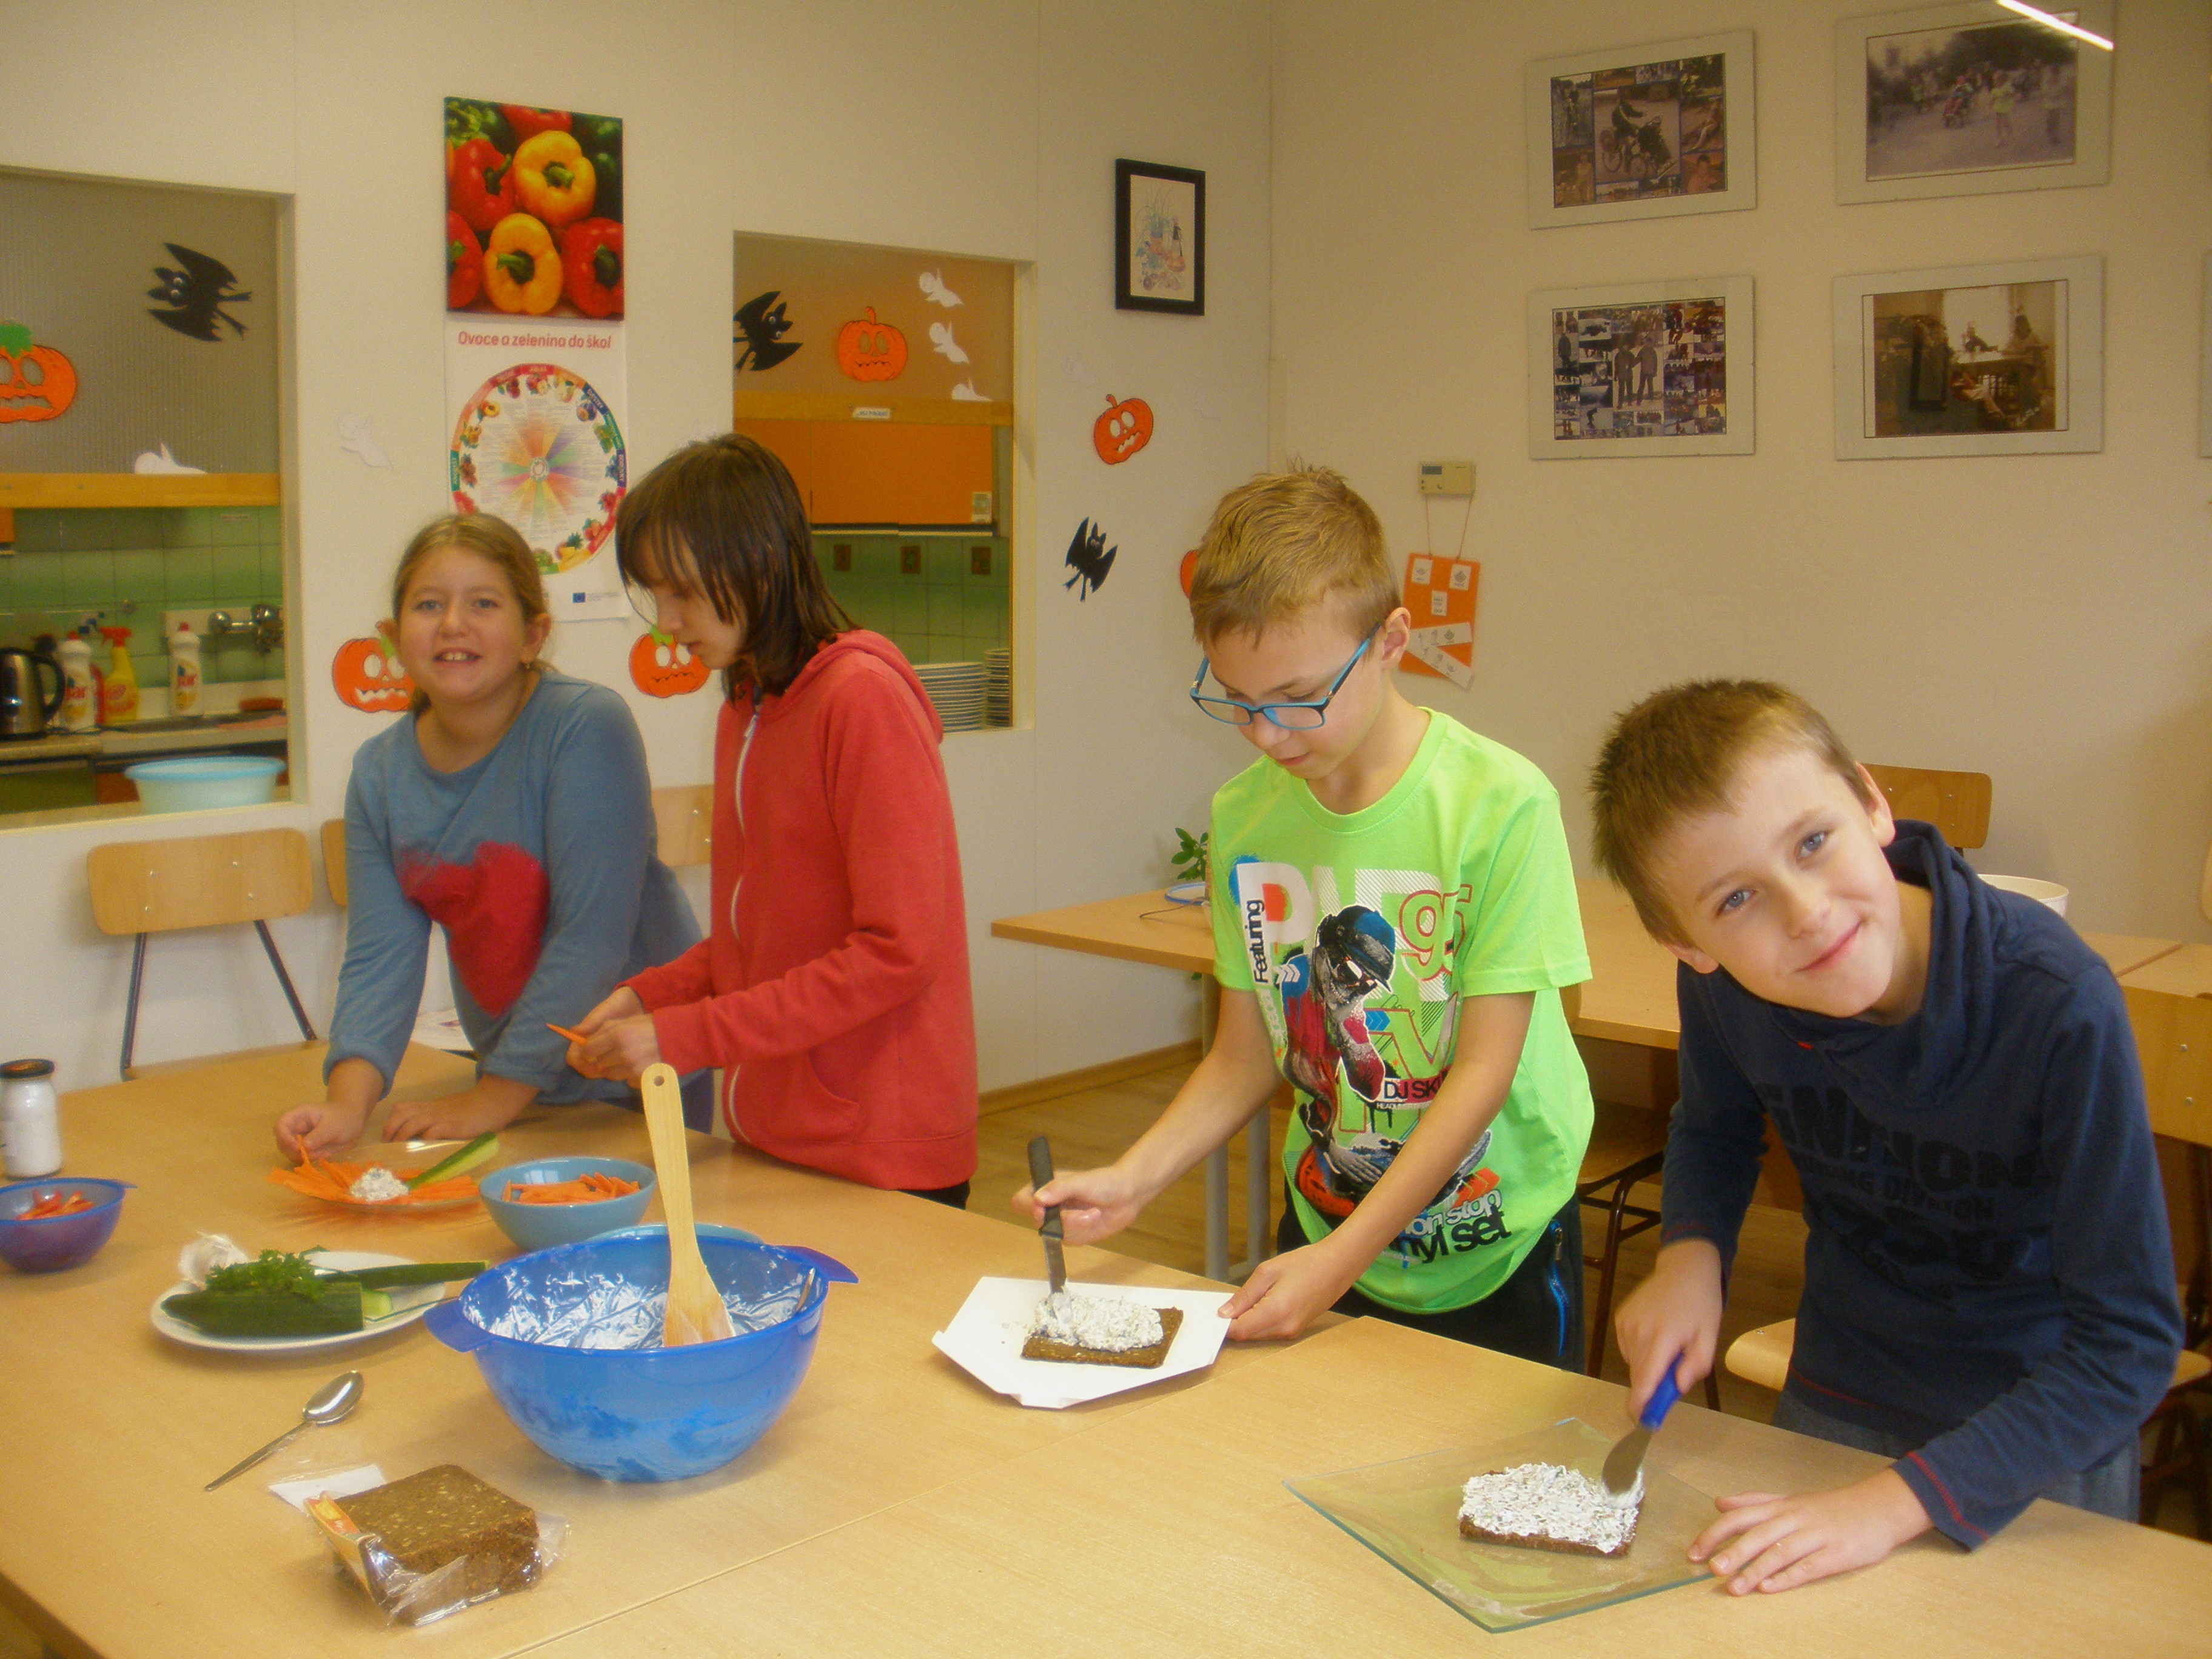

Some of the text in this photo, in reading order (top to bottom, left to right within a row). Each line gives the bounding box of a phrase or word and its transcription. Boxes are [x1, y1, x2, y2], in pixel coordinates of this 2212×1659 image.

[458, 331, 612, 349] Ovoce a zelenina do škol
[1244, 899, 1268, 983] Featuring
[1384, 1081, 1408, 1099] DJ
[1446, 1189, 1502, 1225] stop
[1451, 1204, 1512, 1252] set
